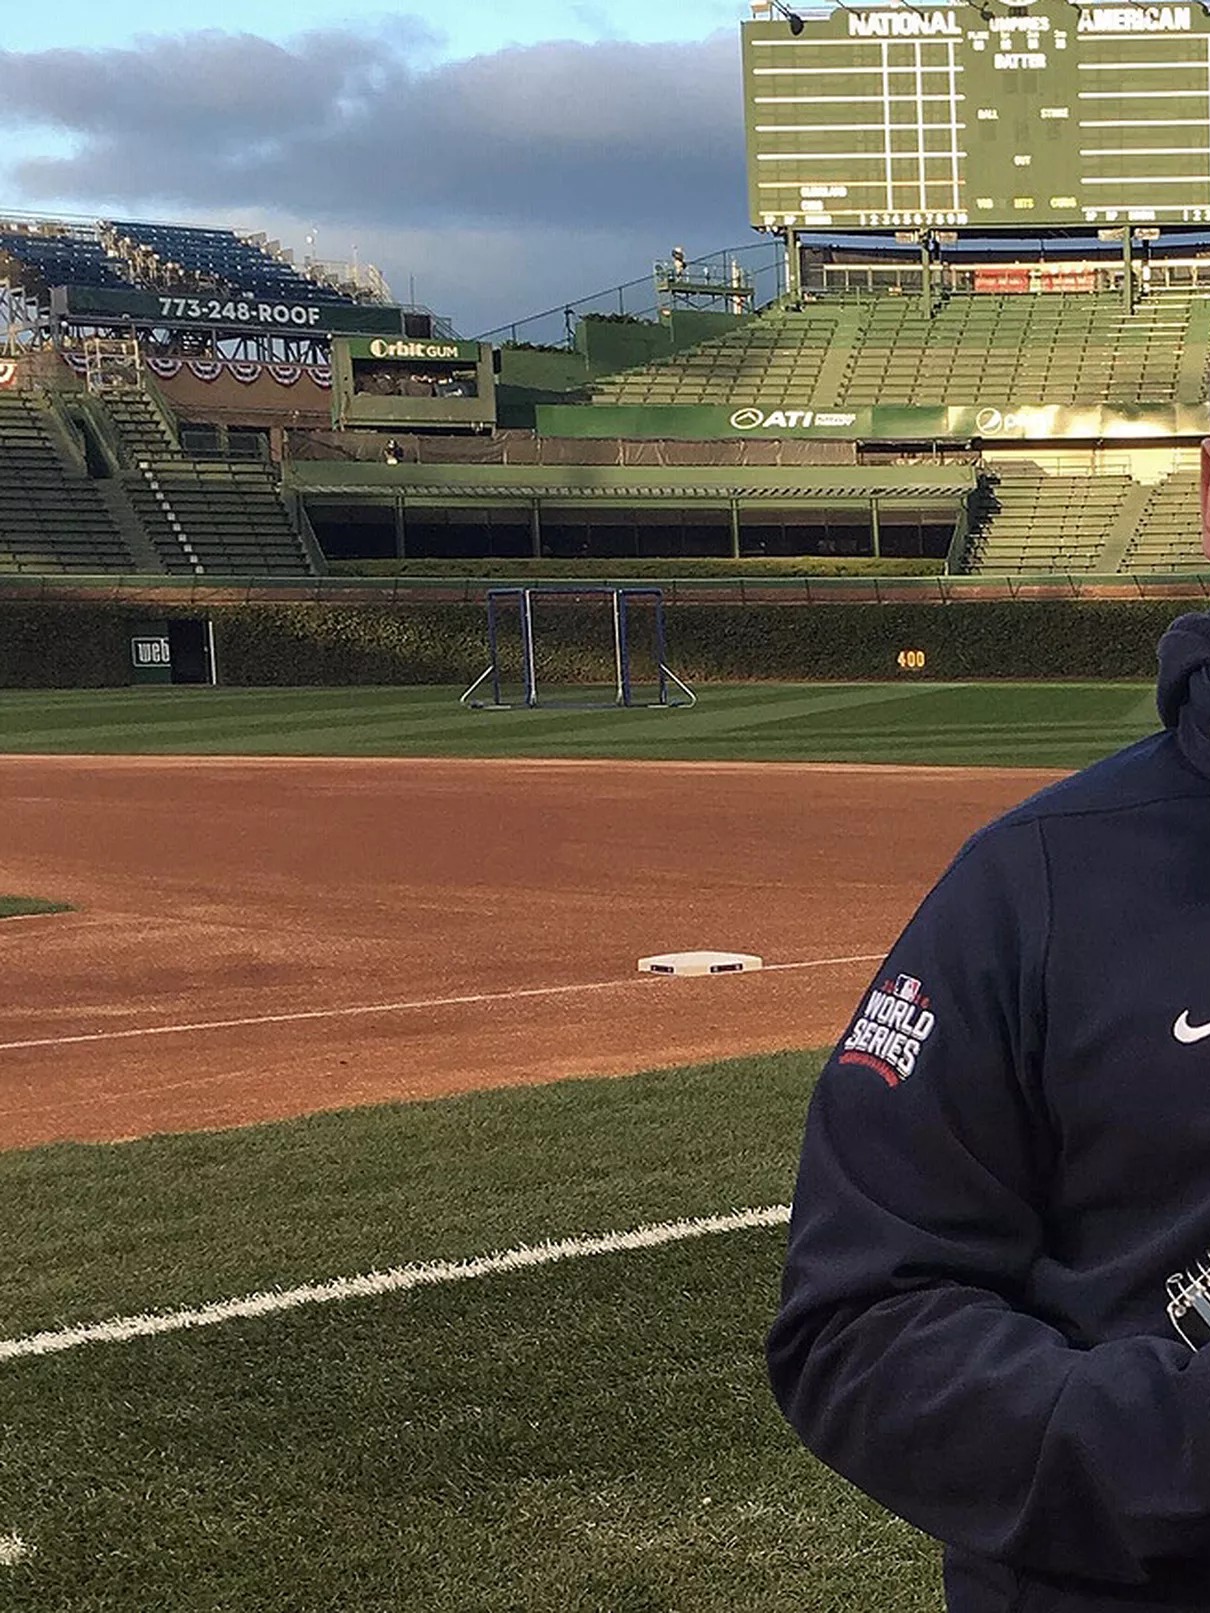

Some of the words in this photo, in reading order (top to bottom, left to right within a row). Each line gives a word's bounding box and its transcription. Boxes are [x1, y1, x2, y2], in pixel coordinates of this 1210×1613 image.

[849, 11, 962, 36] NATIONAL
[1077, 7, 1191, 32] AMERICAN
[159, 297, 320, 326] 773-248-ROOF
[370, 339, 425, 358] Orbit
[426, 345, 458, 358] GUM
[762, 410, 814, 428] ATI
[897, 651, 925, 667] 400
[864, 989, 935, 1040] WORLD
[844, 1018, 920, 1081] SERIES
